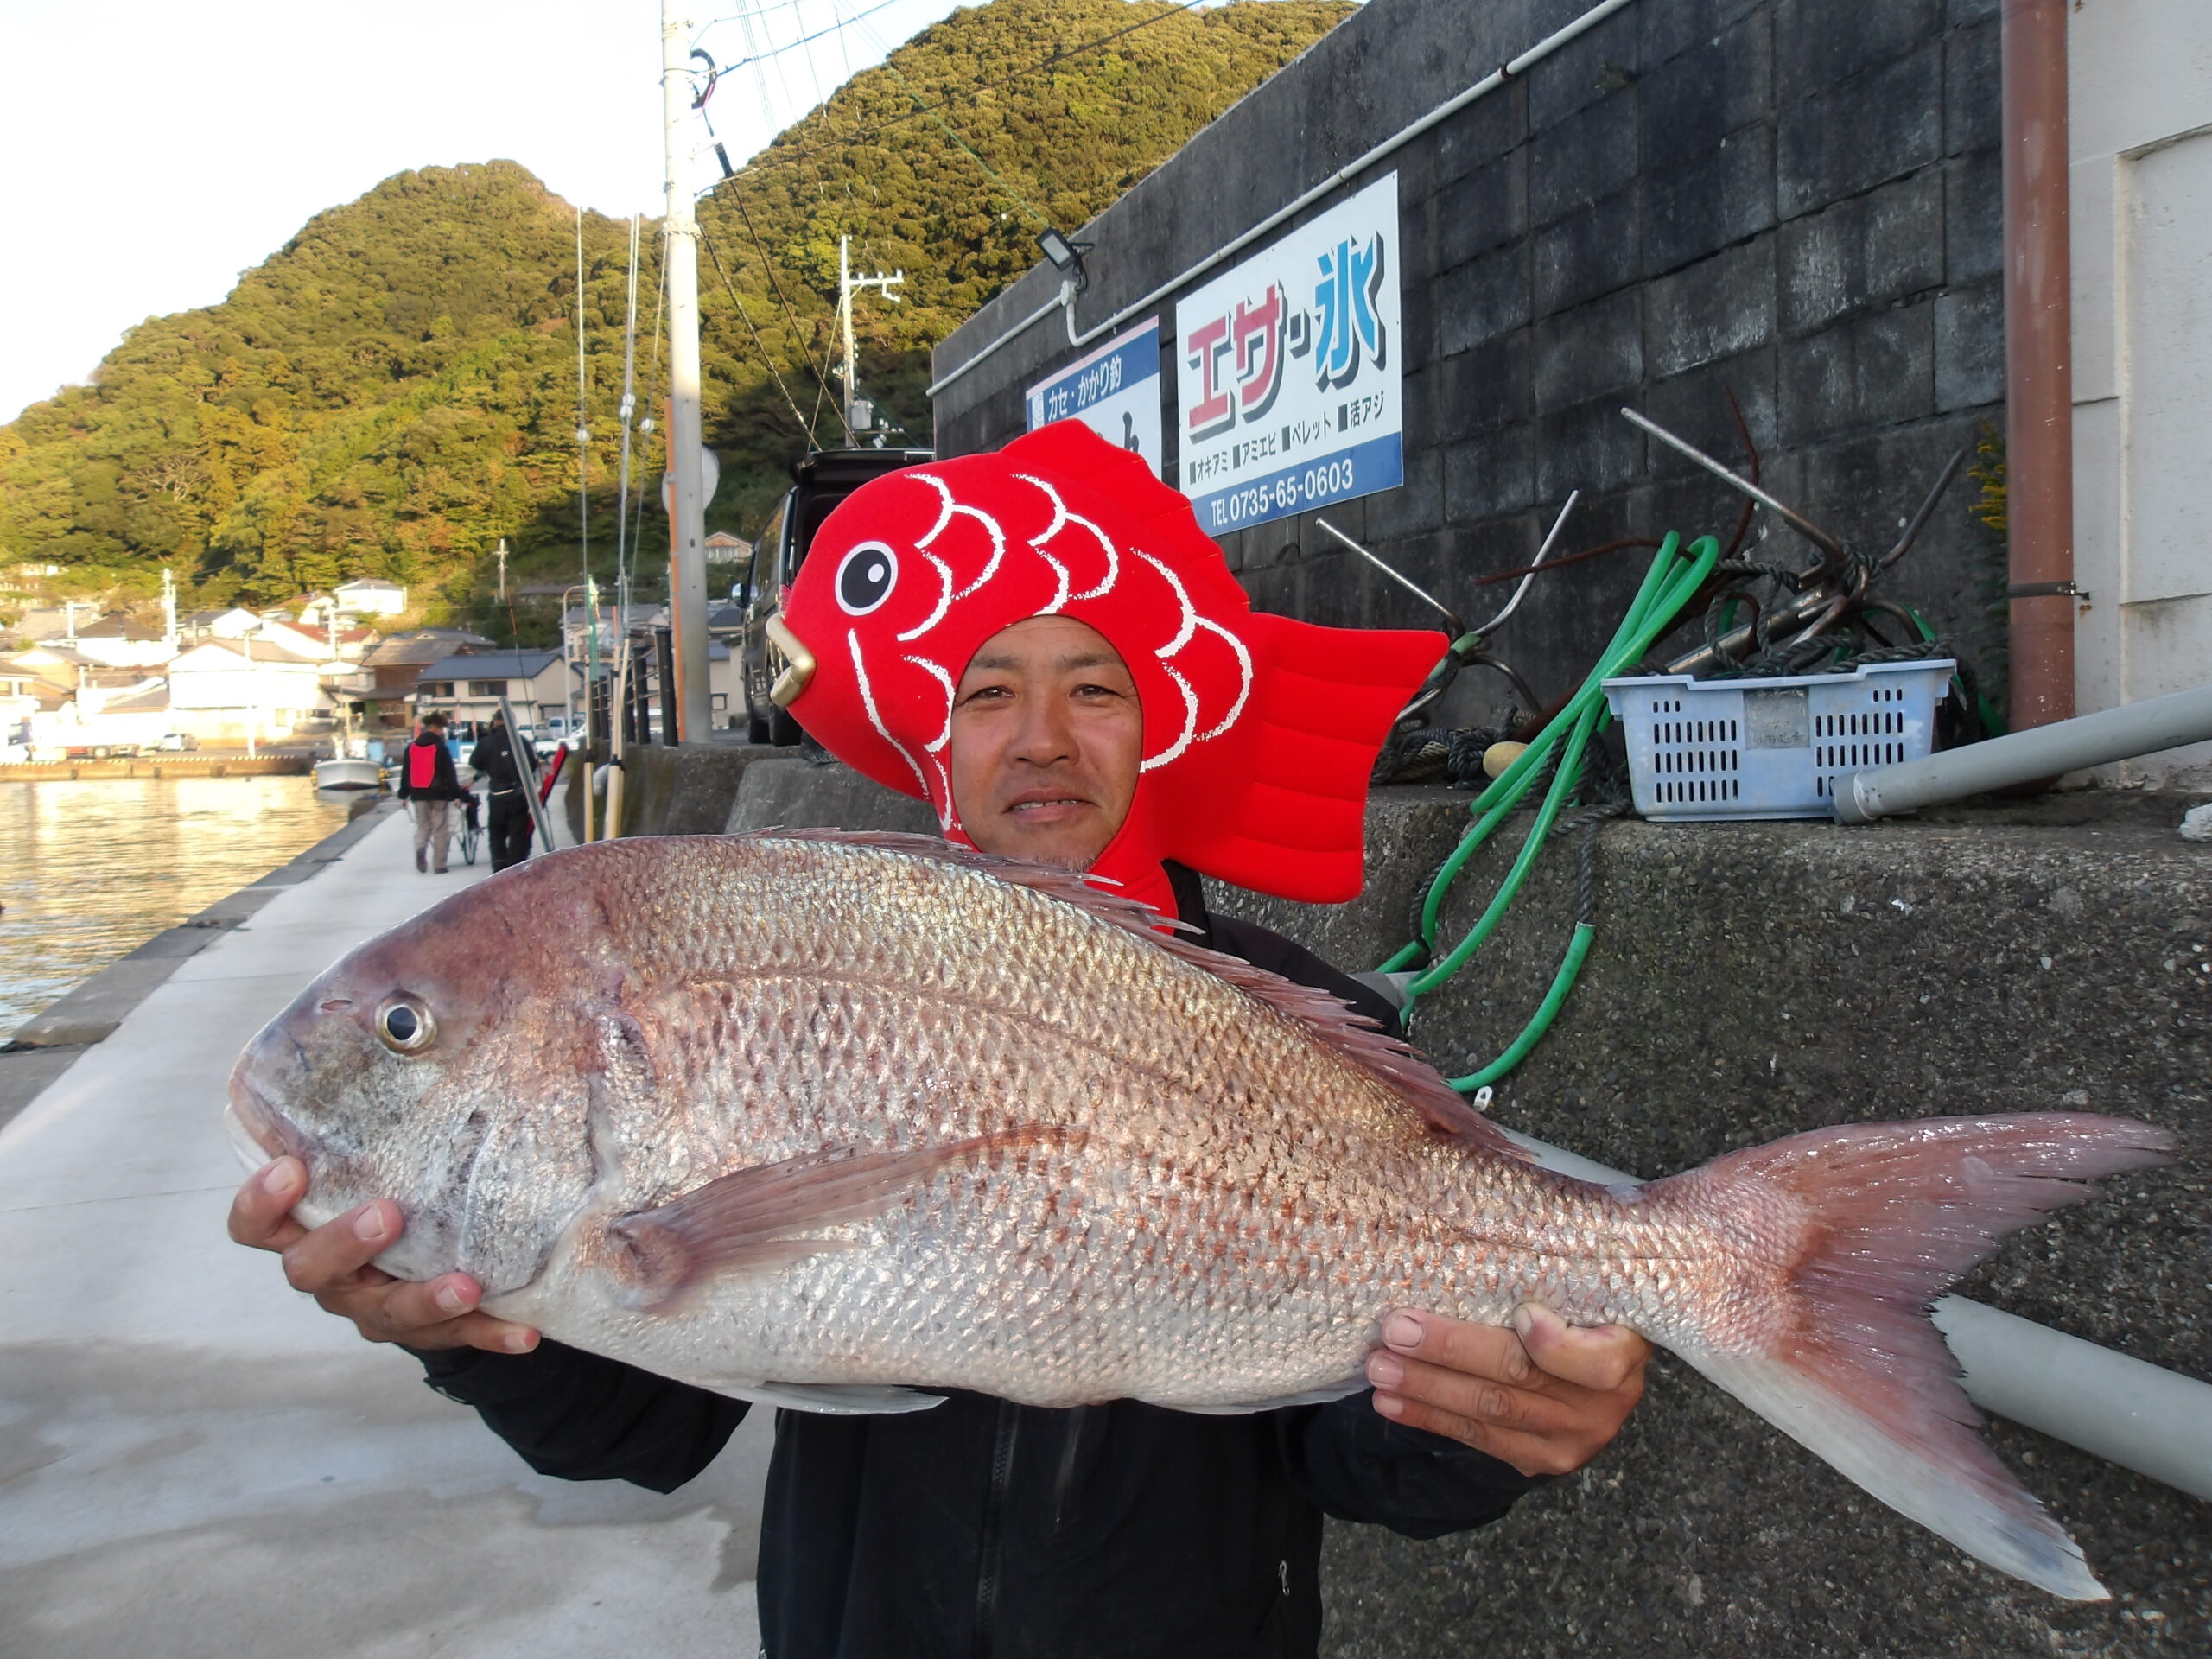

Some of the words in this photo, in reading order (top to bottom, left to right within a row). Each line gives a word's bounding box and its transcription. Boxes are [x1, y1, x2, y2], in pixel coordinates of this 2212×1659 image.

[1198, 450, 1228, 481] オキアミ
[1242, 432, 1276, 465] アミエビ
[1292, 411, 1331, 445] ペレット
[1350, 391, 1384, 428] 活アジ
[1211, 498, 1228, 527] TEL
[1230, 459, 1353, 522] 0735-65-0603
